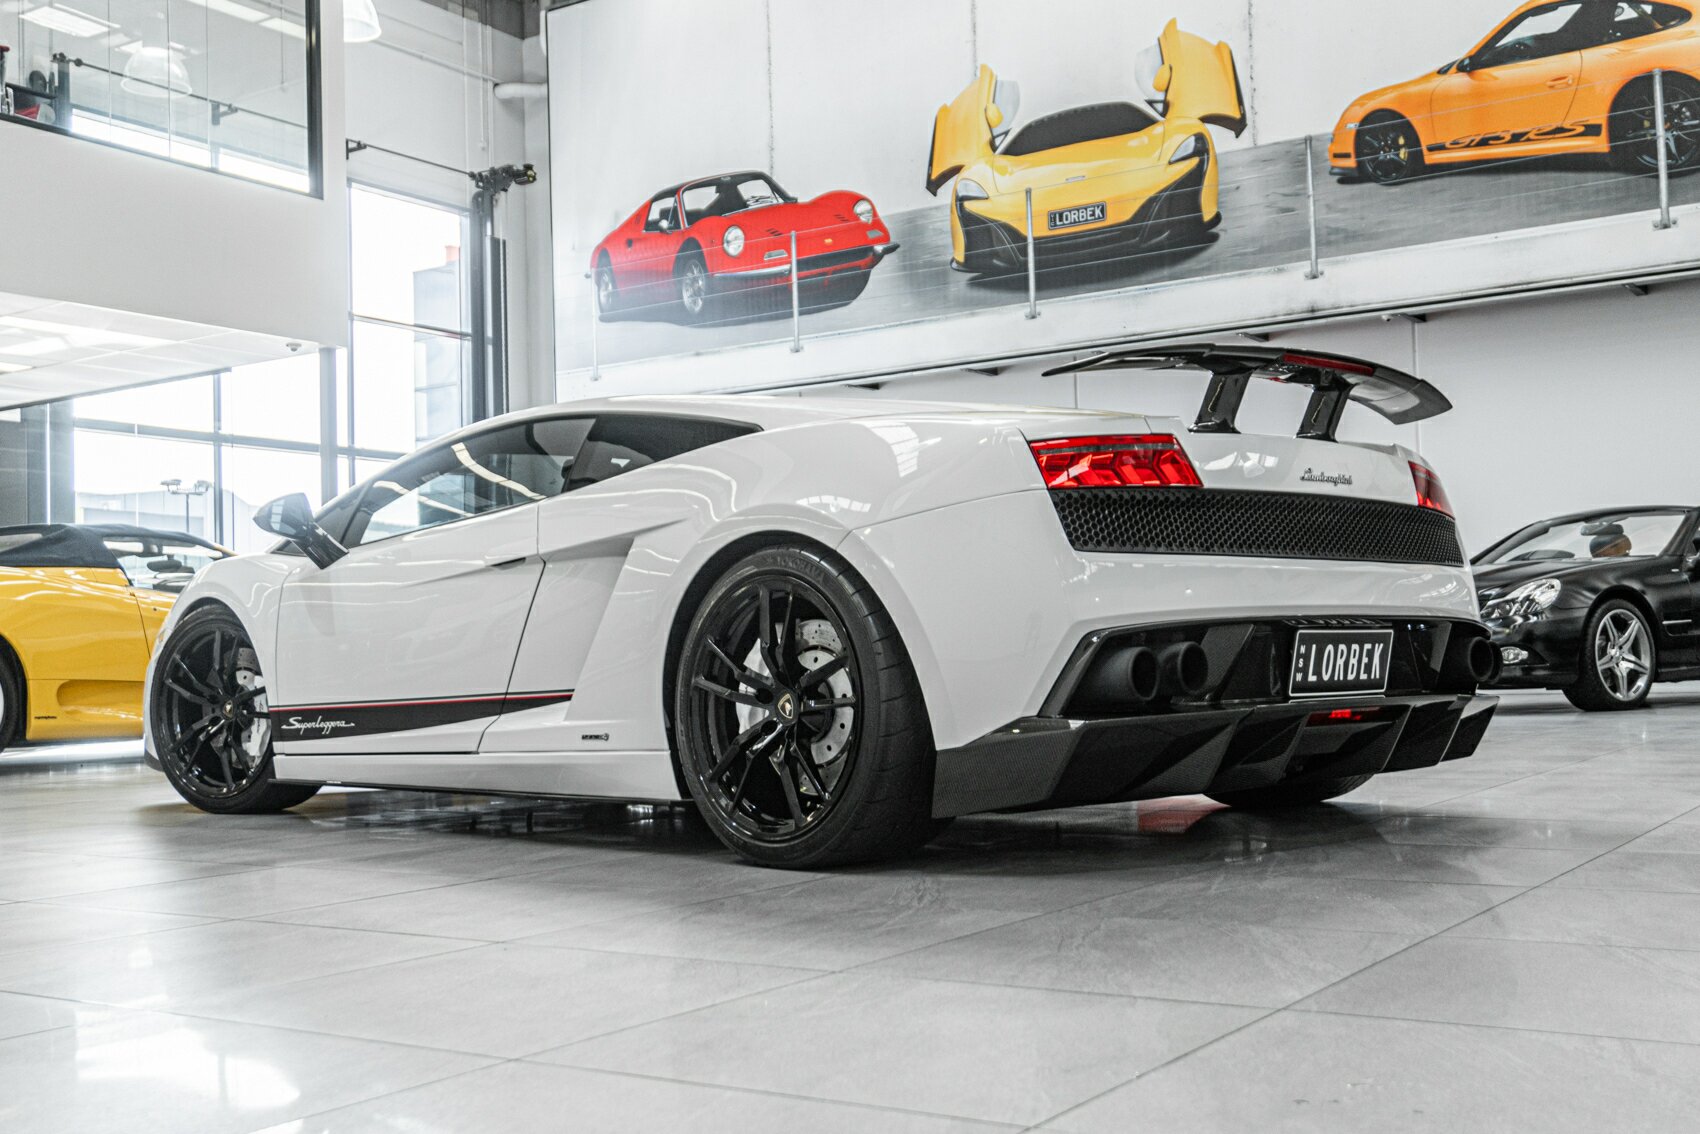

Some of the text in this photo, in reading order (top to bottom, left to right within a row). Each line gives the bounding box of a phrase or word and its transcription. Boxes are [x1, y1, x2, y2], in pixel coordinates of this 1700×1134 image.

[1055, 205, 1104, 226] LORBEK
[1307, 642, 1384, 682] LORBEK
[280, 715, 355, 735] Superleggera
